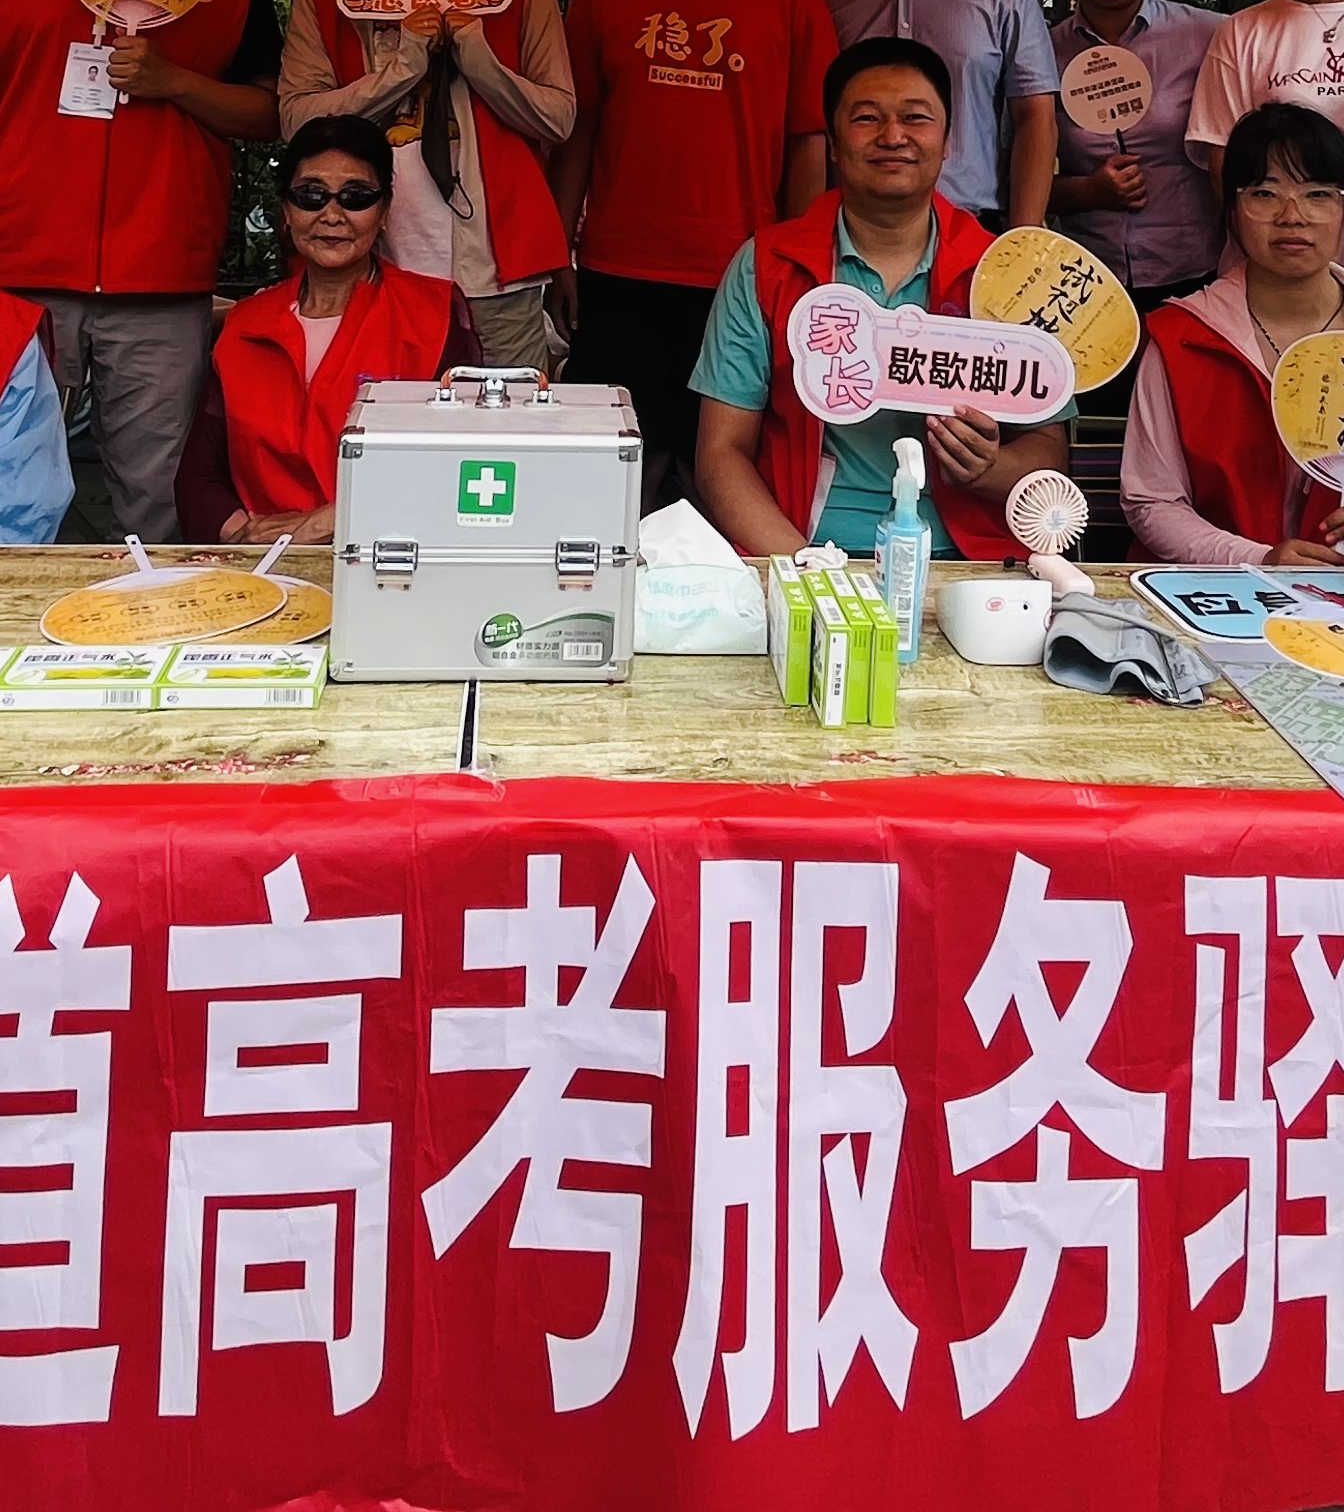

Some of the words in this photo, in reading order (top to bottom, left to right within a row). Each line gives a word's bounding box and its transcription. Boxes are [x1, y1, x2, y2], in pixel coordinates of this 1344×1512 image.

[650, 68, 721, 88] Successful
[807, 303, 873, 410] 家长
[887, 345, 1049, 400] 歇歇脚儿
